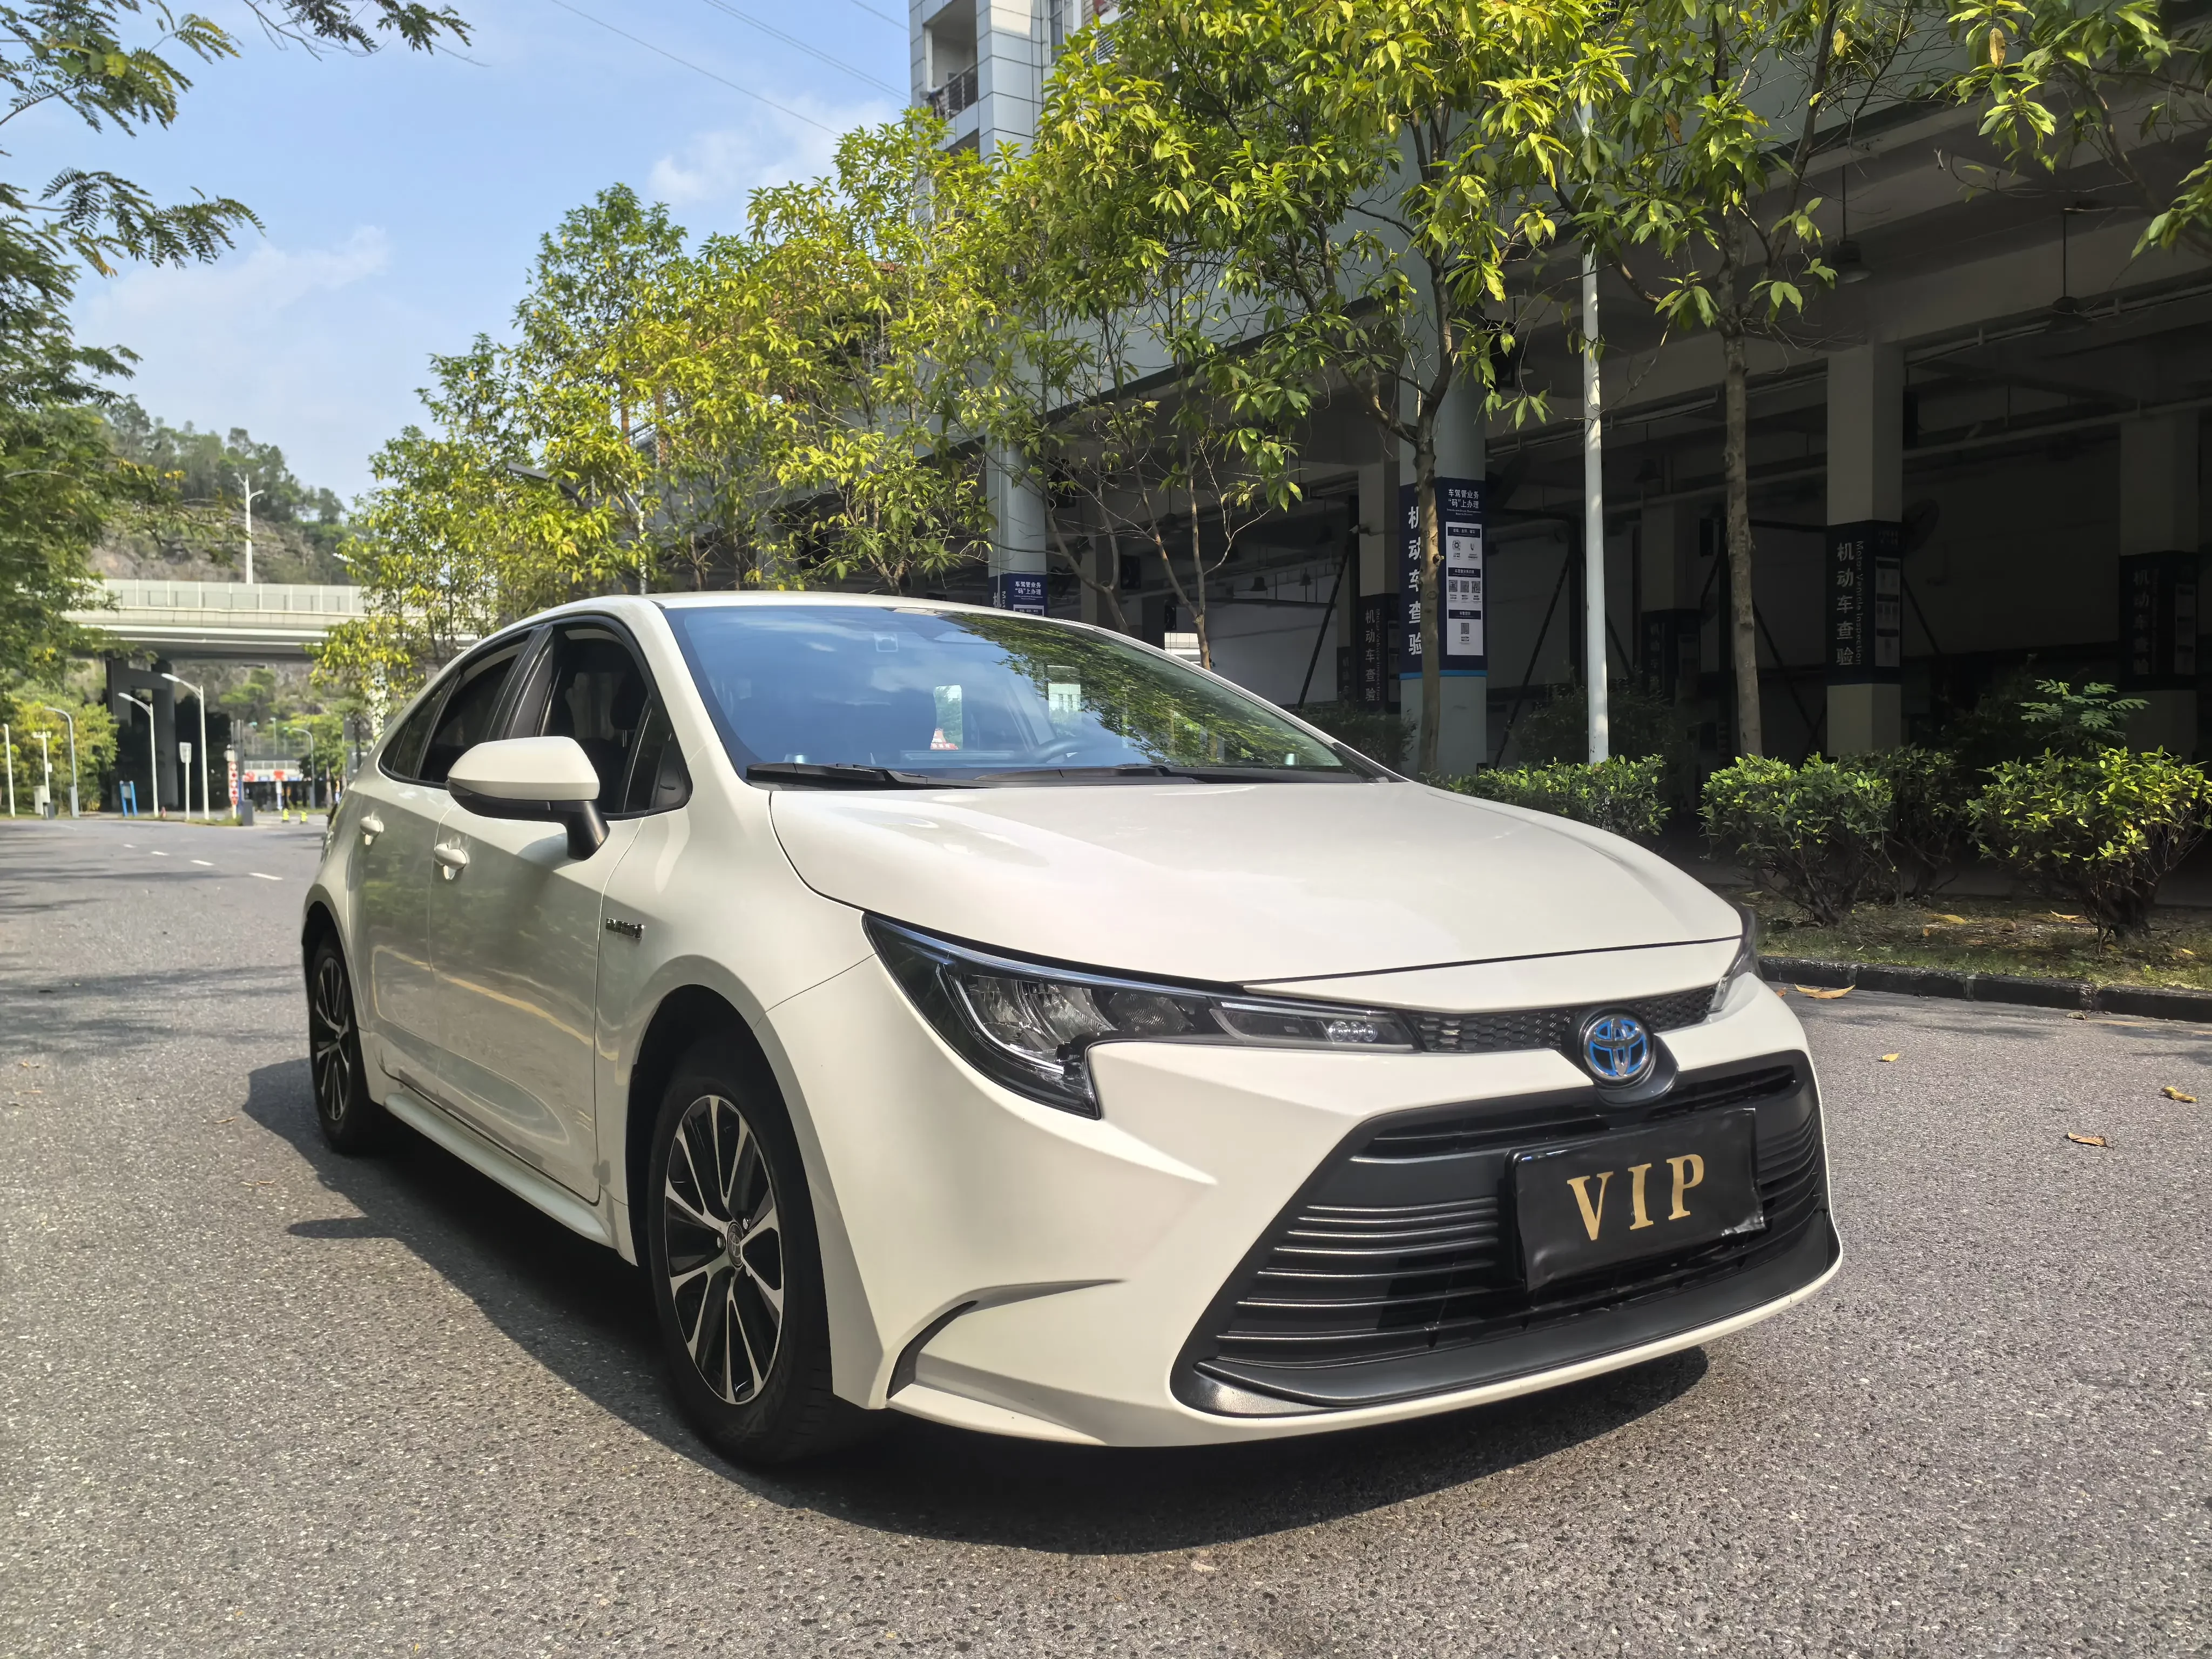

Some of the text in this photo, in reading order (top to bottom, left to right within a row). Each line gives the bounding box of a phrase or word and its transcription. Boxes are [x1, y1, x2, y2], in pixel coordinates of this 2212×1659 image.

[1448, 489, 1479, 503] 车驾管业务
[1836, 542, 1854, 666] 机动车查验
[1365, 609, 1376, 702] 机动车查验
[1567, 1154, 1704, 1241] VIP
